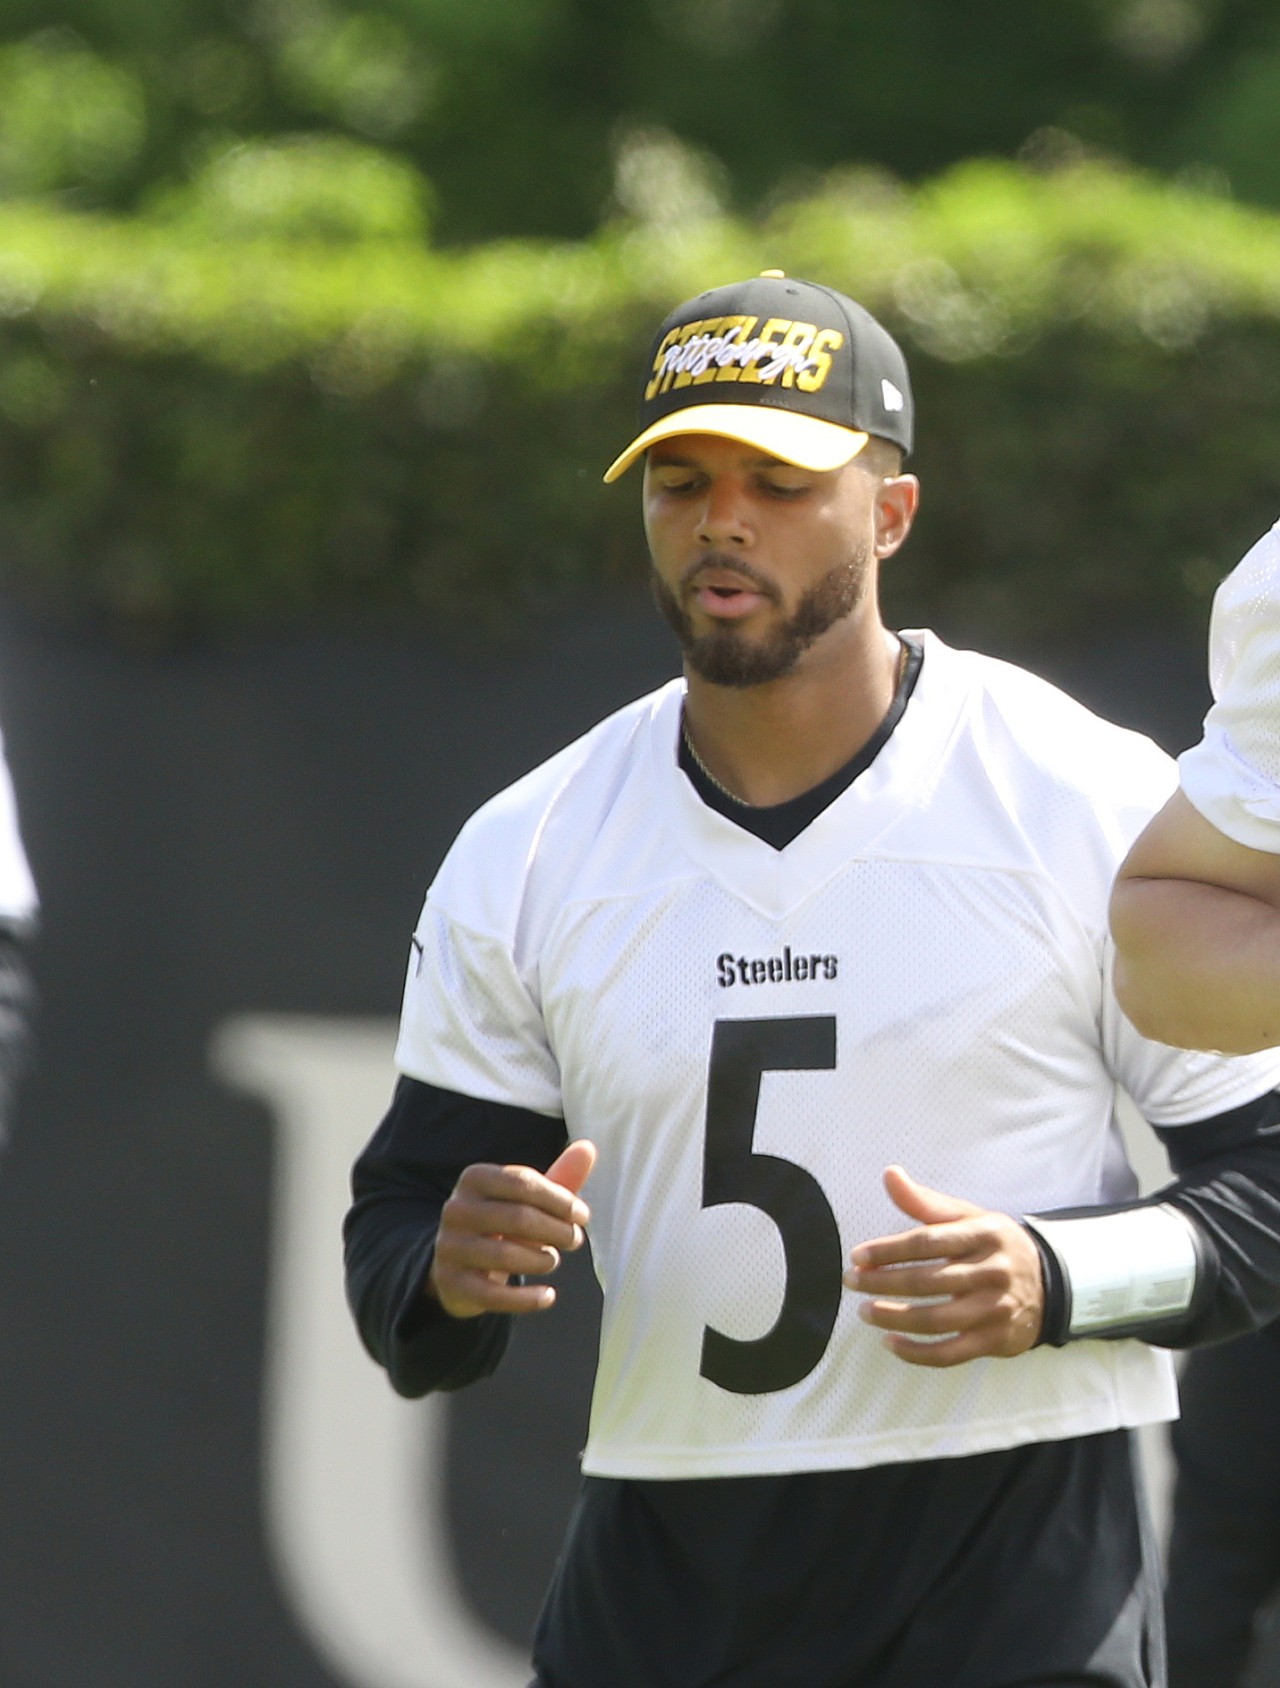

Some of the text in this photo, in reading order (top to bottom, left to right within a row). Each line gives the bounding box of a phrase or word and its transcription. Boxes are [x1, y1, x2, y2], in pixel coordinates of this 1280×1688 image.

[645, 315, 844, 401] STEELERS
[716, 946, 839, 988] Steelers
[700, 1015, 843, 1395] 5
